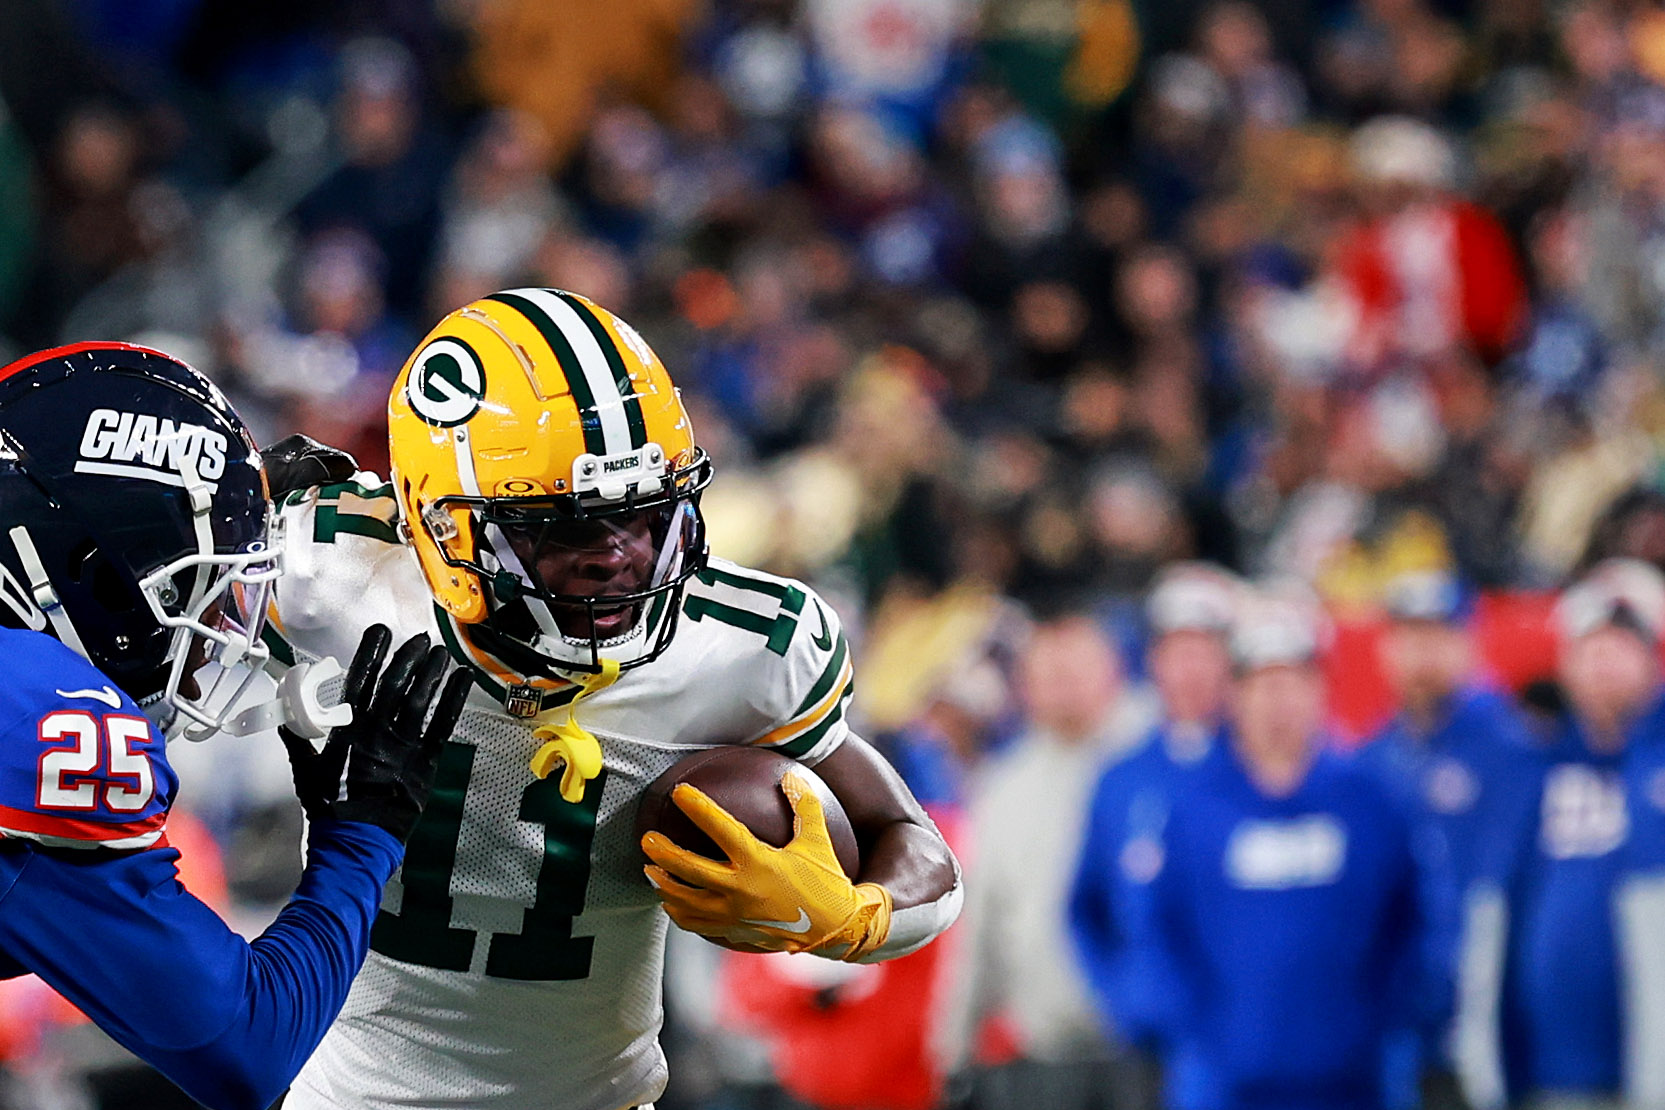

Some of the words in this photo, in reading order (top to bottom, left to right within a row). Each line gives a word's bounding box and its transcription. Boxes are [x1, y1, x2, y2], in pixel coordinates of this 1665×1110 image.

[408, 340, 482, 422] G
[79, 408, 228, 481] GIANTS
[602, 455, 640, 474] PACKERS
[682, 566, 807, 658] 11
[35, 709, 157, 814] 25
[369, 738, 609, 982] 11
